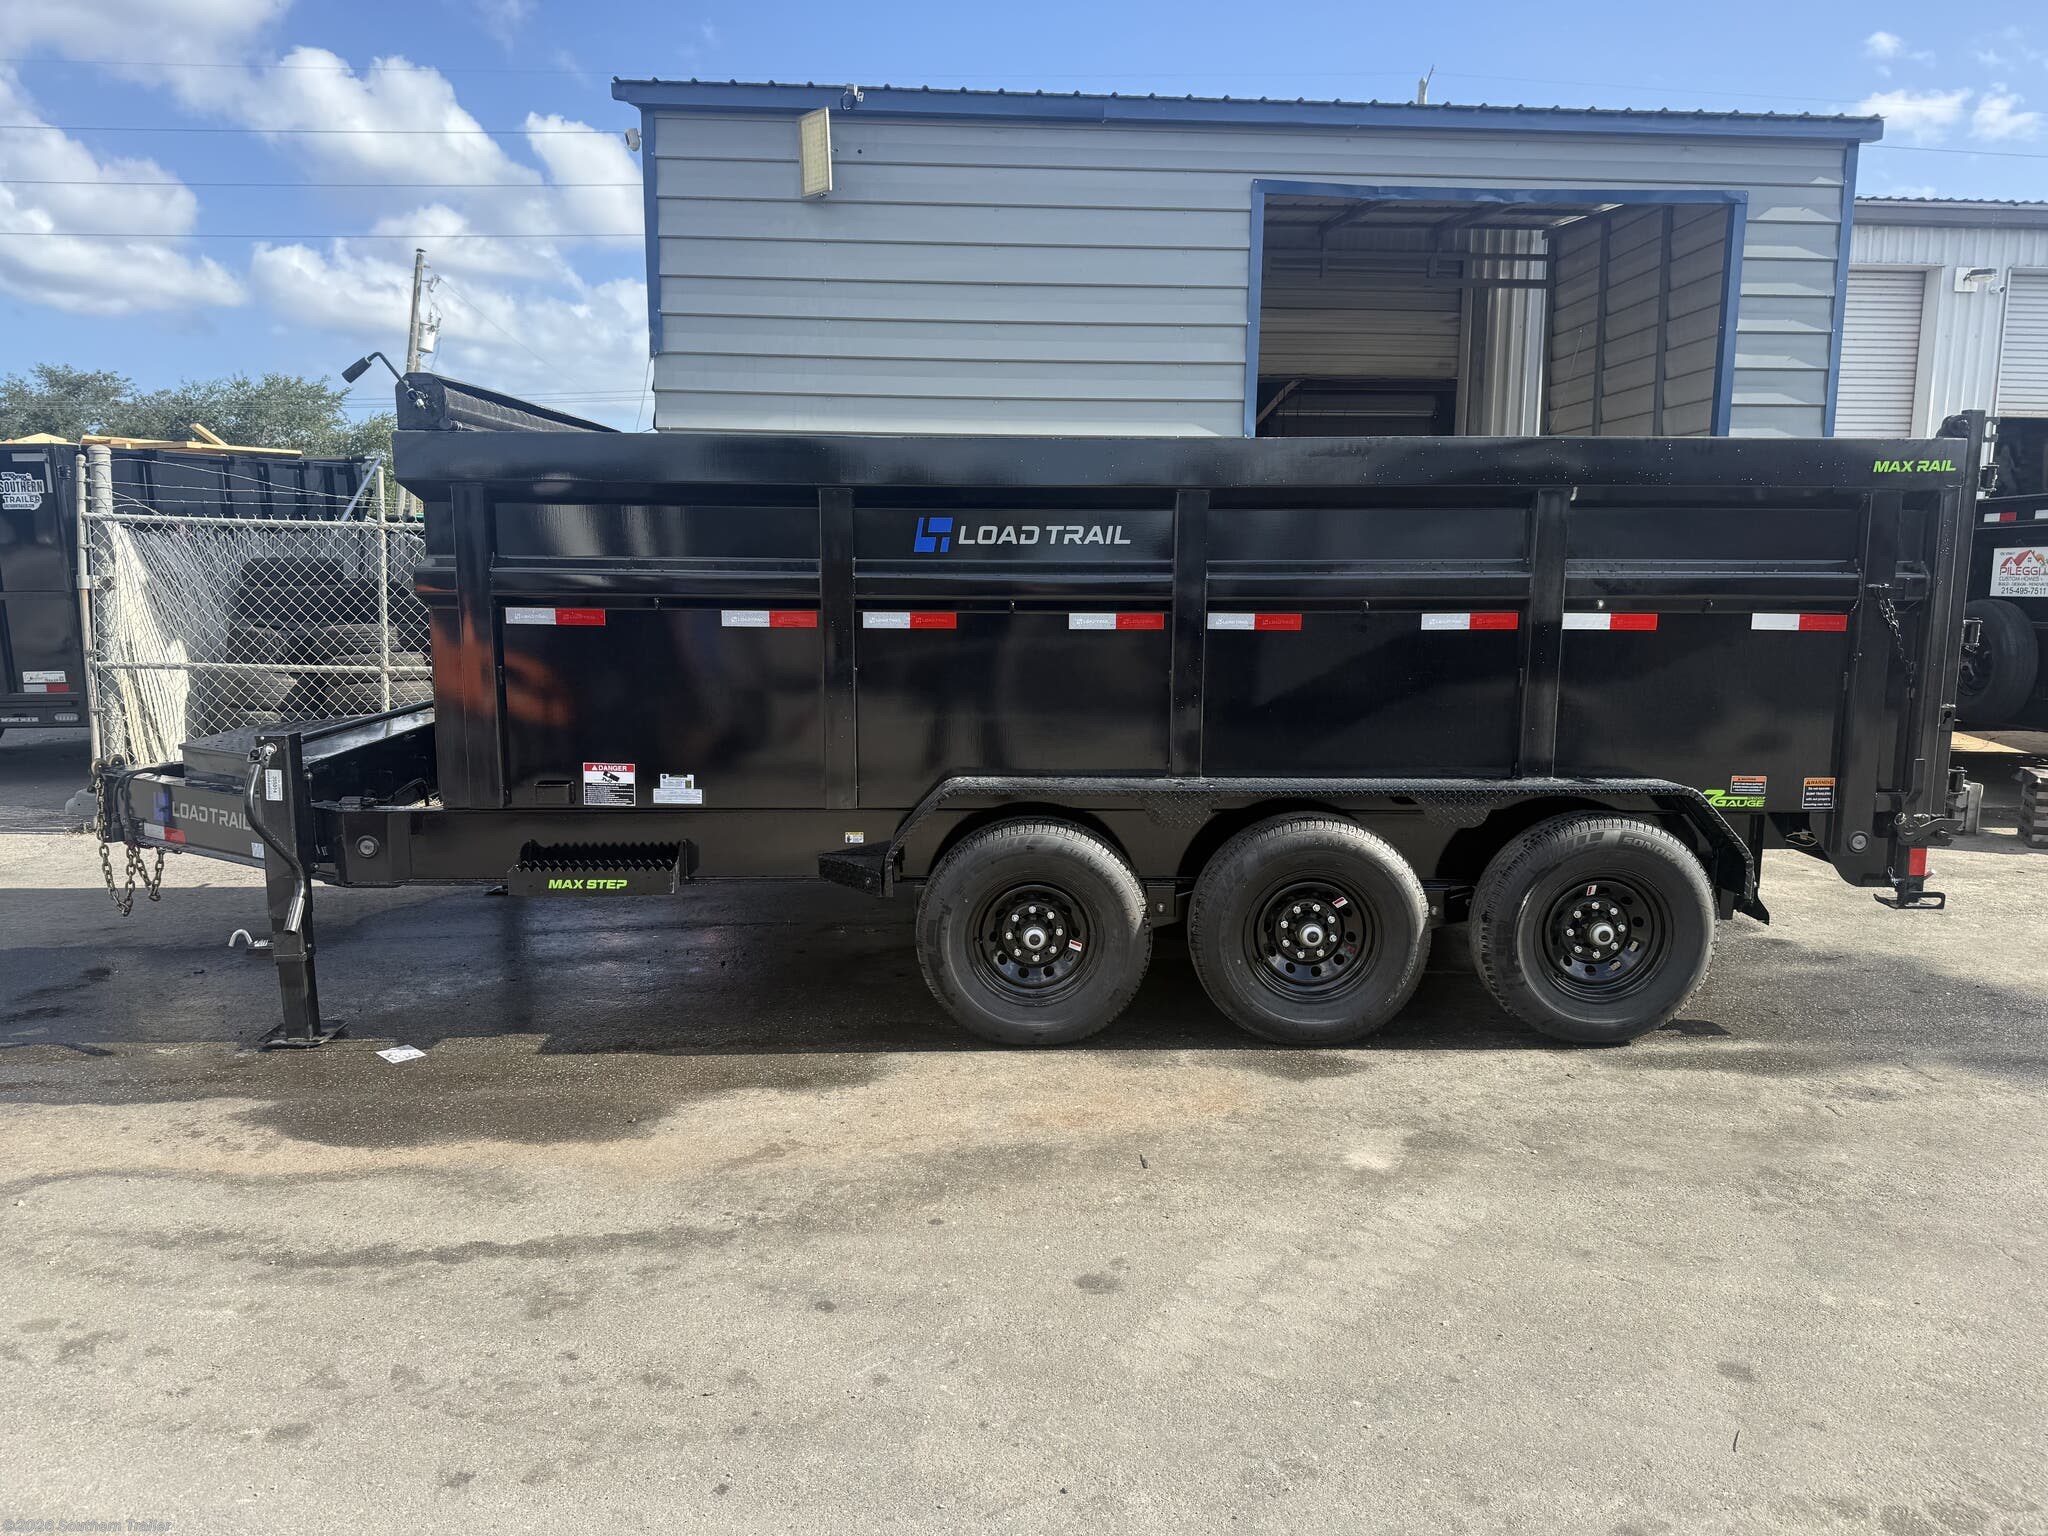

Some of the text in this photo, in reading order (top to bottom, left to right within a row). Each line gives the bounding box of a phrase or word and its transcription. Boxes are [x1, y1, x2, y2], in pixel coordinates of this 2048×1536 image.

[1873, 459, 1956, 472] MAX RAIL
[0, 480, 43, 493] SOUTHERN
[4, 496, 41, 504] TRAILER
[958, 525, 1132, 545] LOAD TRAIL
[1711, 799, 1765, 808] GAUGE
[548, 879, 628, 889] MAX STEP
